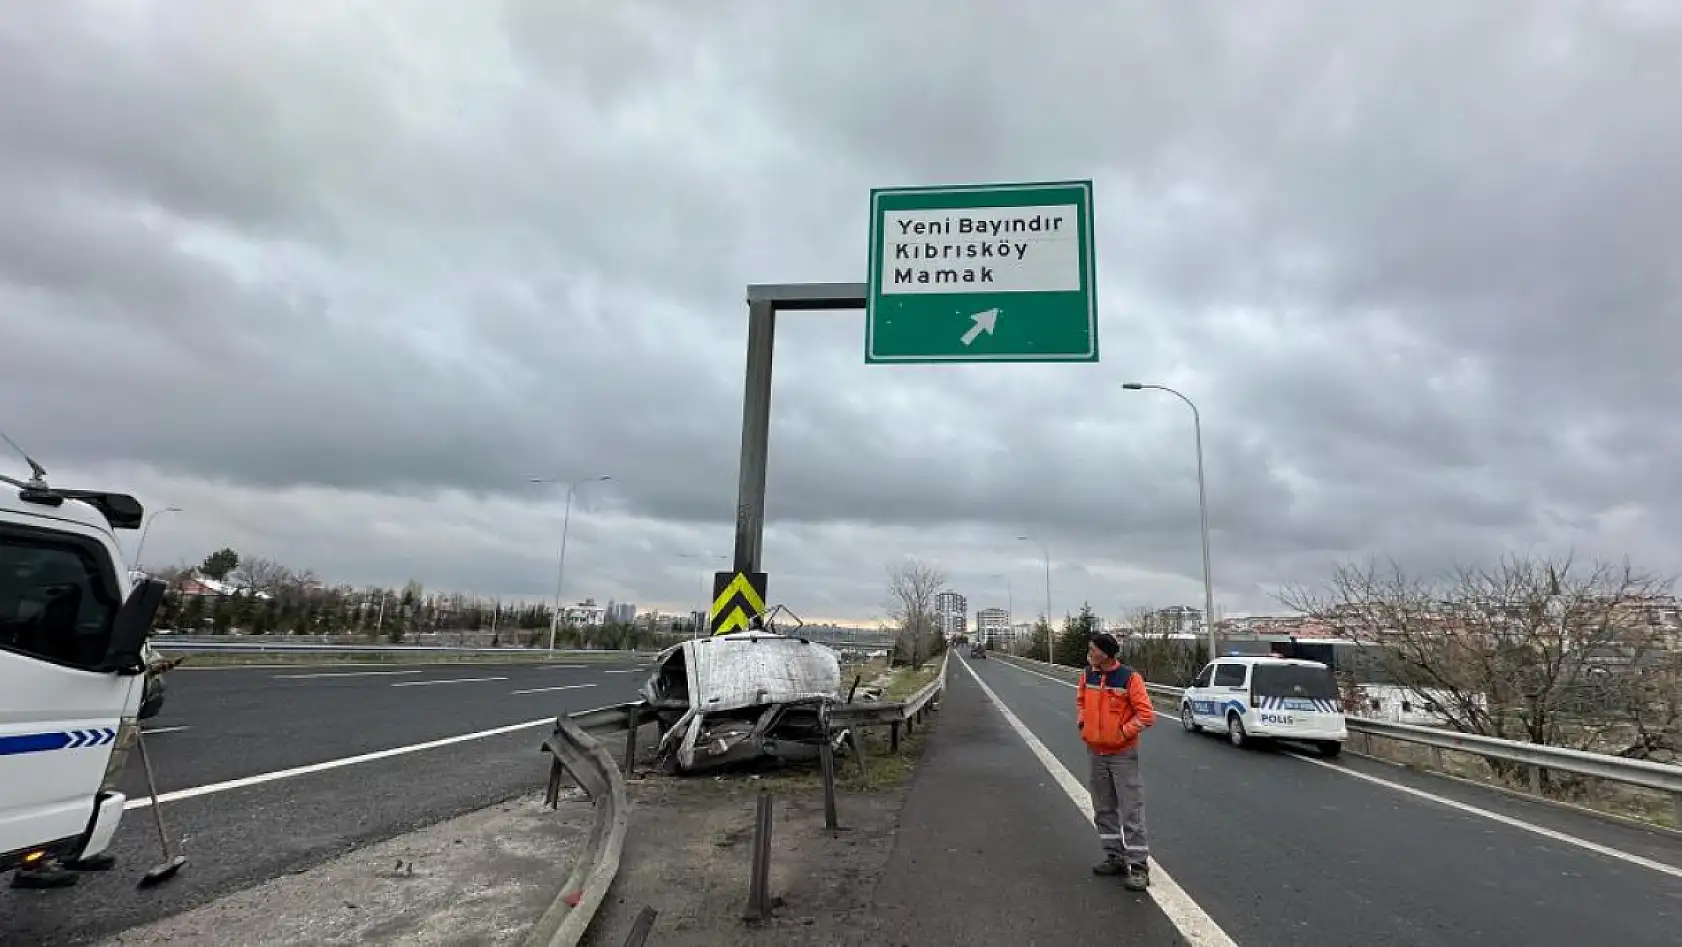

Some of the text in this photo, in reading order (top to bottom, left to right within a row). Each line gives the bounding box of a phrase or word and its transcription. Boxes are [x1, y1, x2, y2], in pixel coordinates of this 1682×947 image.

[898, 215, 1063, 236] Yeni Bayındır
[895, 240, 1028, 260] Kıbrısköy
[894, 267, 994, 284] Mamak
